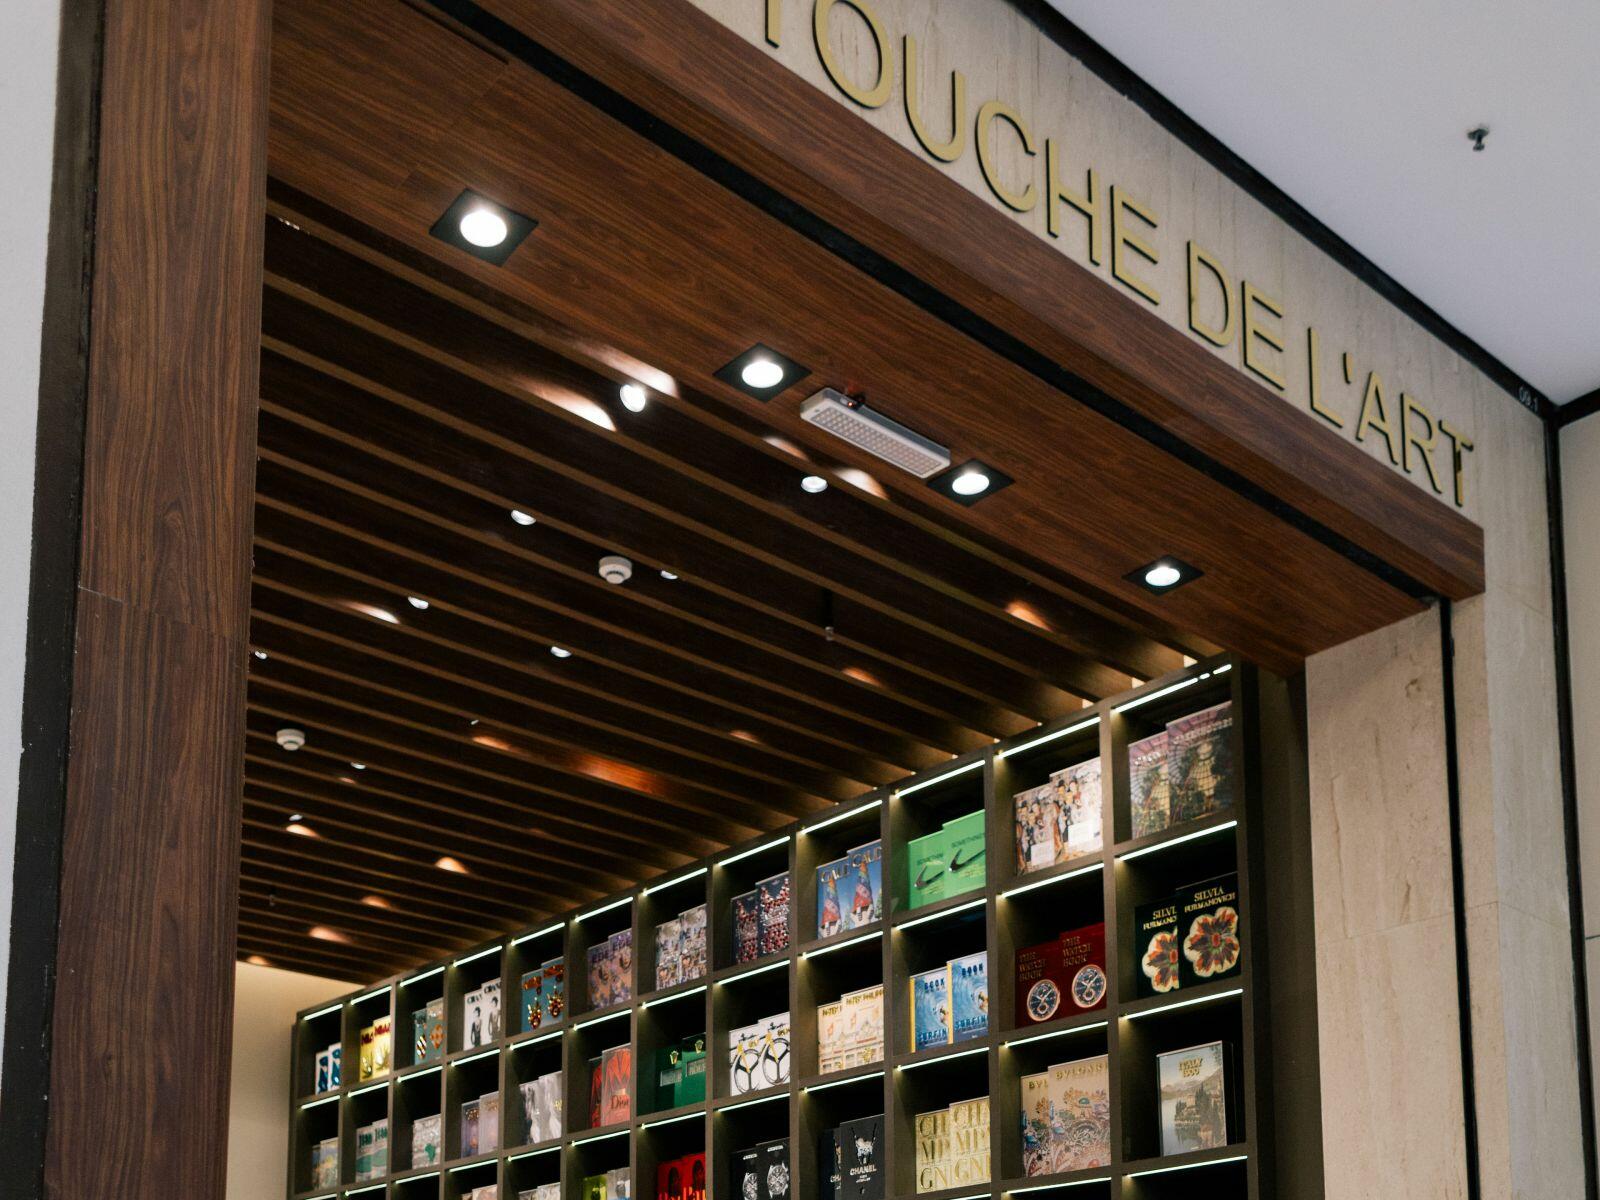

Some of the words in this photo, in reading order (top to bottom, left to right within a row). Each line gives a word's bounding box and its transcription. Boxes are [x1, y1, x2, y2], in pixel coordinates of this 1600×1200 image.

[766, 0, 1160, 306] OUCHE
[1187, 239, 1286, 391] DE
[1308, 326, 1474, 508] L'ART
[1194, 886, 1225, 902] SILVIA
[1184, 892, 1236, 913] FURMANOVICH
[1152, 905, 1177, 920] SILVI
[955, 1015, 987, 1030] SURFIN
[917, 1028, 947, 1042] SURFIN
[849, 1164, 878, 1176] CHANEL
